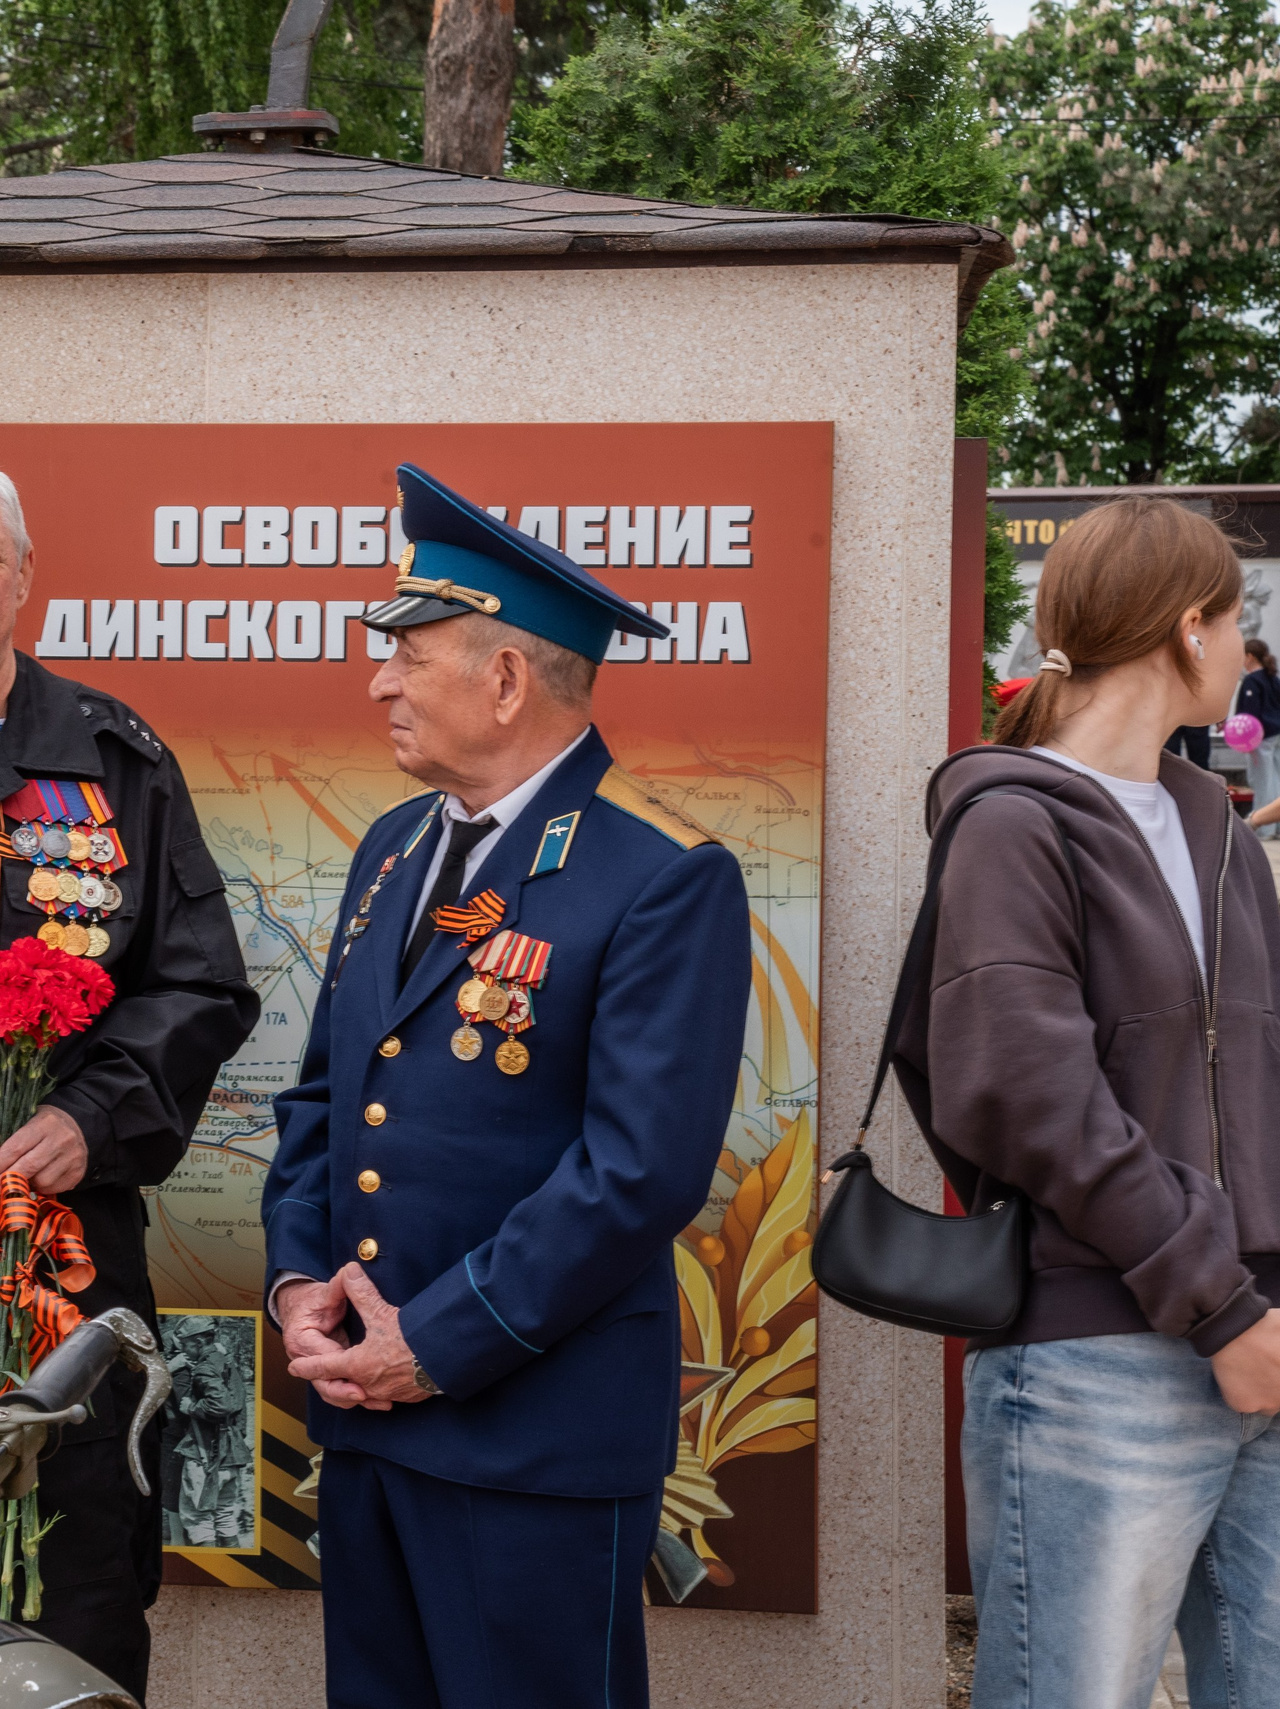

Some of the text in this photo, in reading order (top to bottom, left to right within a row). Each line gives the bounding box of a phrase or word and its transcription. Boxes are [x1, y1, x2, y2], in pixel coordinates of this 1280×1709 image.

[154, 506, 753, 566] ОСВОБДЕНИЕ
[991, 519, 1056, 545] ЧТО
[695, 792, 741, 801] САЛЬСК
[281, 895, 305, 909] 58А
[264, 1012, 288, 1026] 17А
[217, 1072, 284, 1084] Марьянская
[210, 1093, 276, 1104] РАСНОД
[229, 1162, 254, 1177] 47А
[165, 1183, 224, 1194] Геленджик
